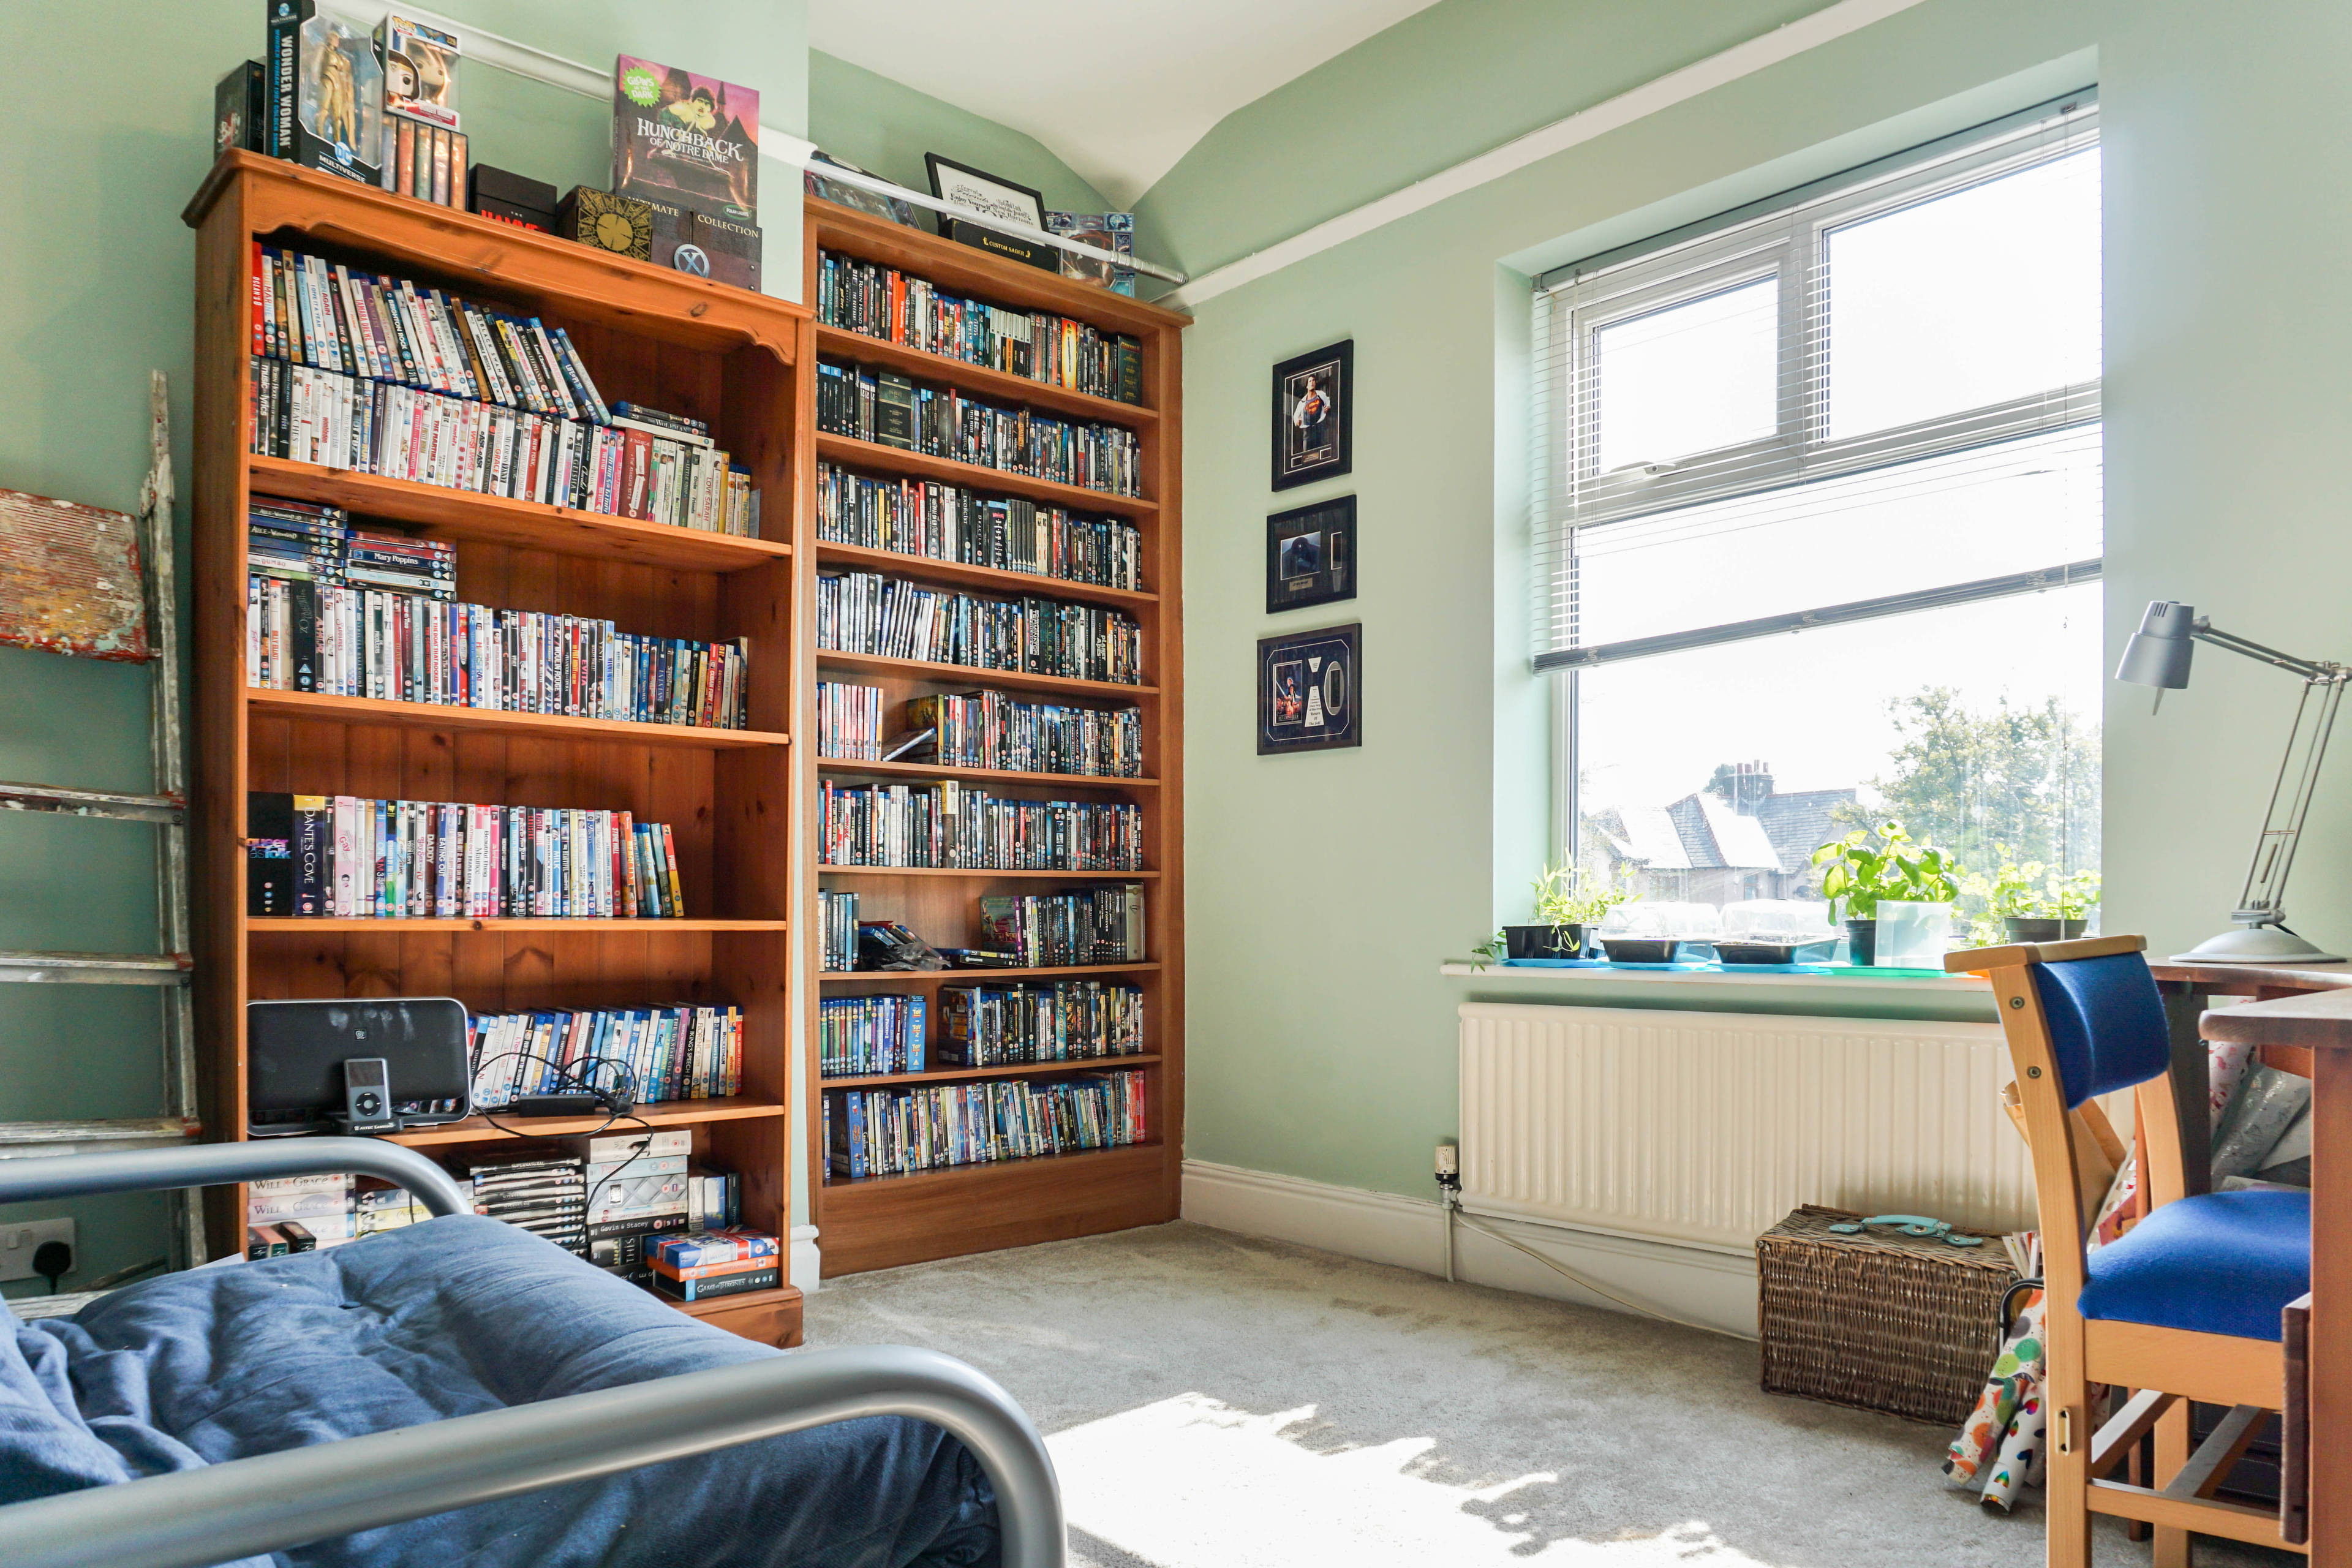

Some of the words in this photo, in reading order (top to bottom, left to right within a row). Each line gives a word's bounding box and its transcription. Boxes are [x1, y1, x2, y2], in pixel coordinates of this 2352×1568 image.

[281, 36, 293, 92] WONDER
[627, 76, 654, 86] GLOWS
[631, 90, 654, 100] DARK
[280, 95, 293, 146] WOMAN
[637, 117, 744, 162] HUNCHBACK
[649, 136, 663, 146] OF
[665, 140, 701, 157] NOTRE
[701, 149, 729, 164] DAME
[336, 144, 353, 164] DC
[319, 155, 366, 184] MULTIVERSE
[951, 193, 968, 205] Enjoy
[968, 200, 991, 210] Yourself
[697, 214, 759, 238] COLLECTION
[1008, 212, 1034, 225] Horizons
[989, 241, 1008, 250] CUSTOM
[1008, 245, 1025, 255] SABER
[322, 293, 331, 315] AGAIN
[355, 300, 368, 321] TAMARA
[388, 300, 401, 331] BRIGHTON
[397, 333, 408, 350] ROCK
[480, 323, 493, 349] BLACK
[491, 353, 502, 373] SWAN
[262, 364, 270, 388] music
[537, 355, 551, 380] Christmas
[565, 364, 574, 375] LIFE
[260, 394, 270, 416] lyrics
[292, 402, 301, 442] BEACHES
[655, 418, 688, 432] WOLFMAN
[431, 433, 439, 461] MARTINS
[500, 463, 510, 483] VINNY
[262, 558, 287, 567] DUMBO
[392, 555, 418, 565] Poppins
[304, 807, 315, 850] DANTE'S
[339, 835, 352, 853] Gay
[426, 834, 435, 864] DADDY
[304, 852, 315, 884] COVE
[482, 860, 491, 878] Thing
[695, 1022, 704, 1055] FLORENCE
[556, 1040, 565, 1065] IMPOSSIBLE
[627, 1221, 649, 1229] Stacey
[697, 1283, 714, 1293] GAME
[719, 1279, 745, 1290] THRONES
